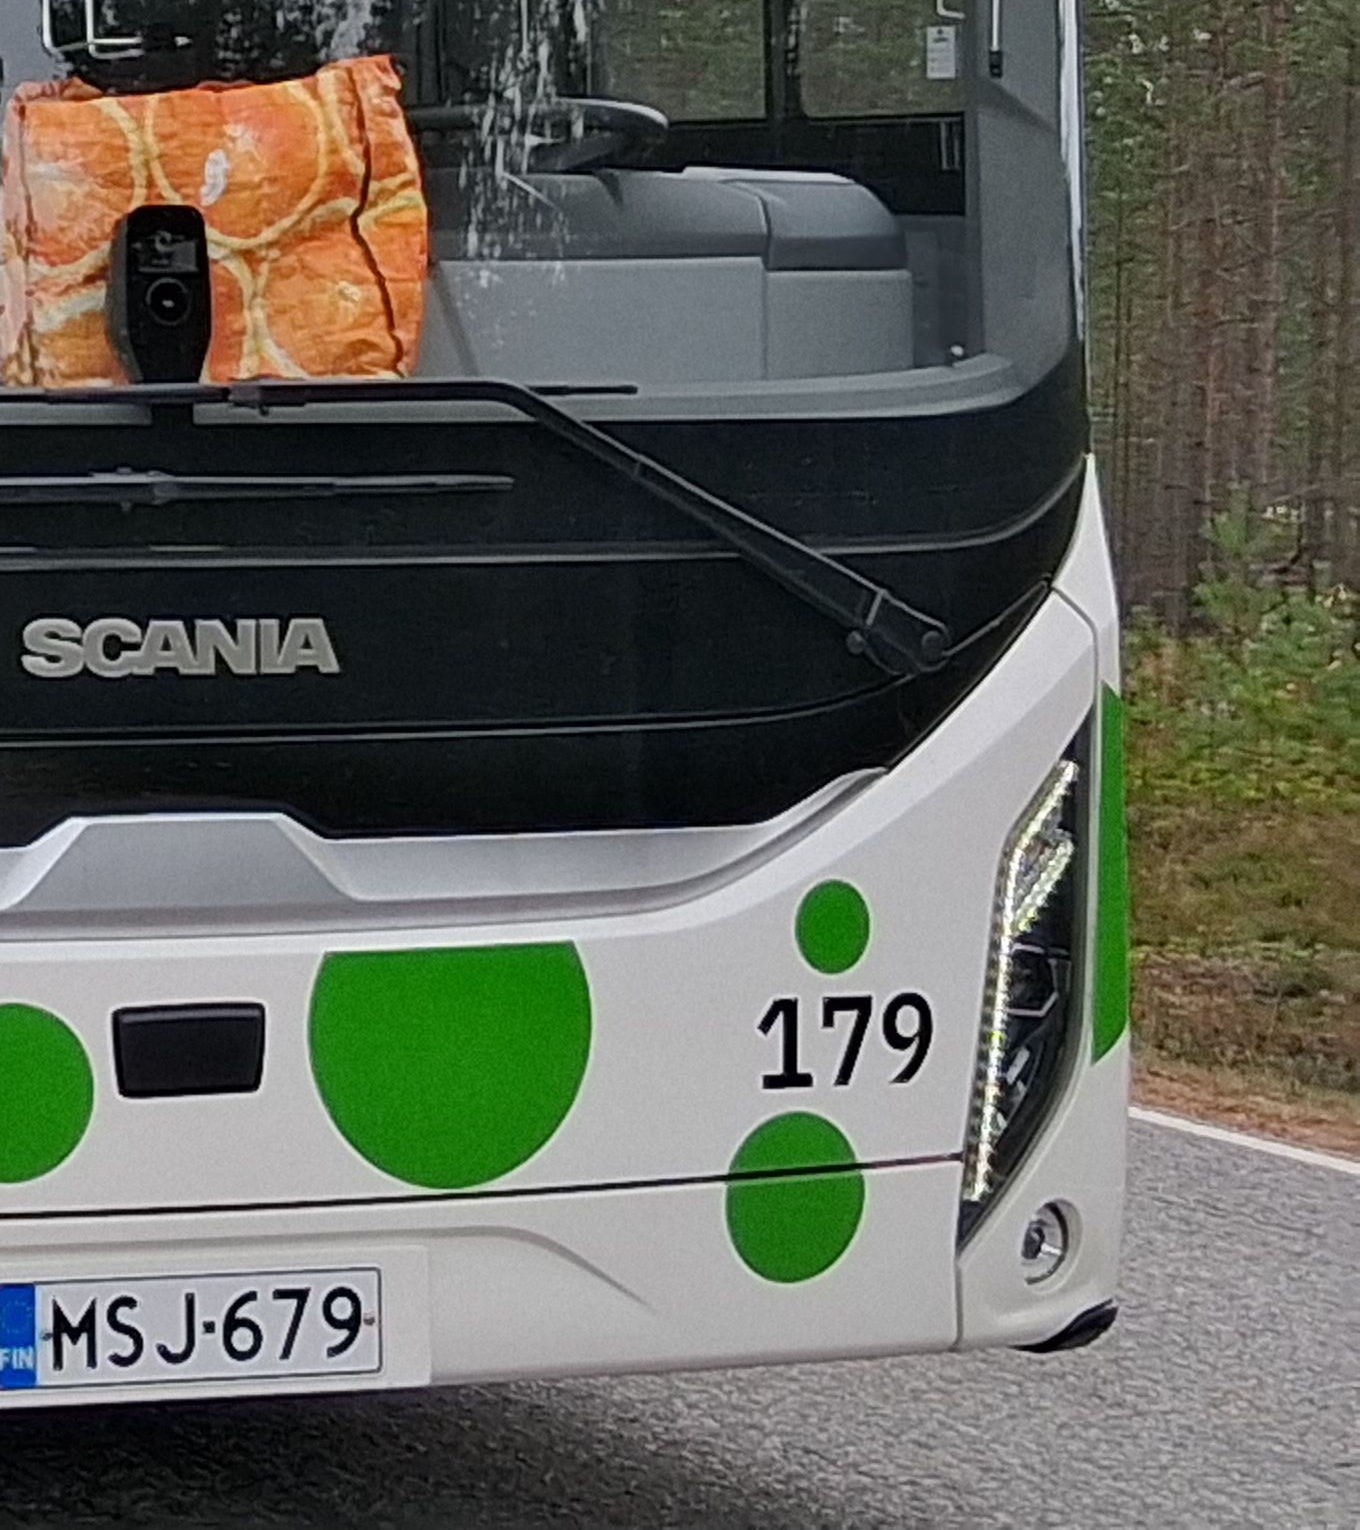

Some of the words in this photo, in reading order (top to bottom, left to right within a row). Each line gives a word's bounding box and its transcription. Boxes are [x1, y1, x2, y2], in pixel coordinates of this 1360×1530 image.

[20, 616, 341, 678] SCANIA
[755, 991, 933, 1090] 179
[51, 1286, 363, 1372] MSJ-679
